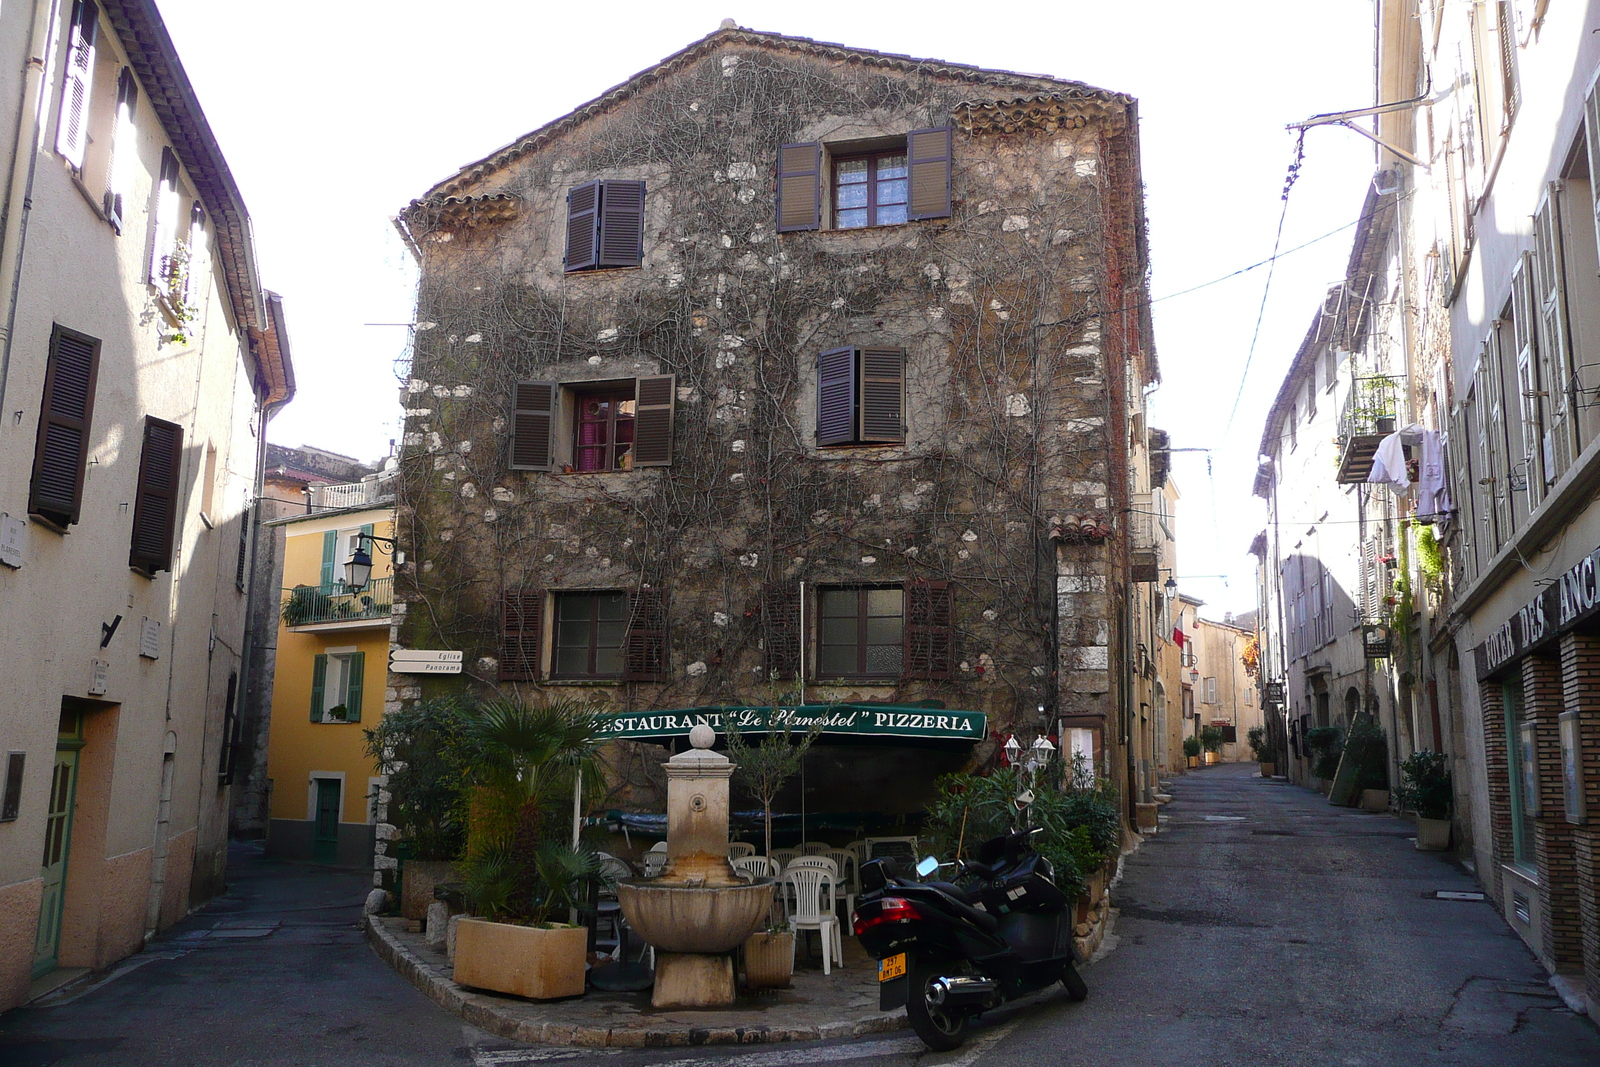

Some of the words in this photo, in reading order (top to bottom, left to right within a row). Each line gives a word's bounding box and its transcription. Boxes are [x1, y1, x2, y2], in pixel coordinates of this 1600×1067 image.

[1484, 619, 1515, 671] FOYER
[1519, 593, 1544, 649] DES
[874, 712, 973, 731] PIZZERIA
[886, 956, 898, 967] 297
